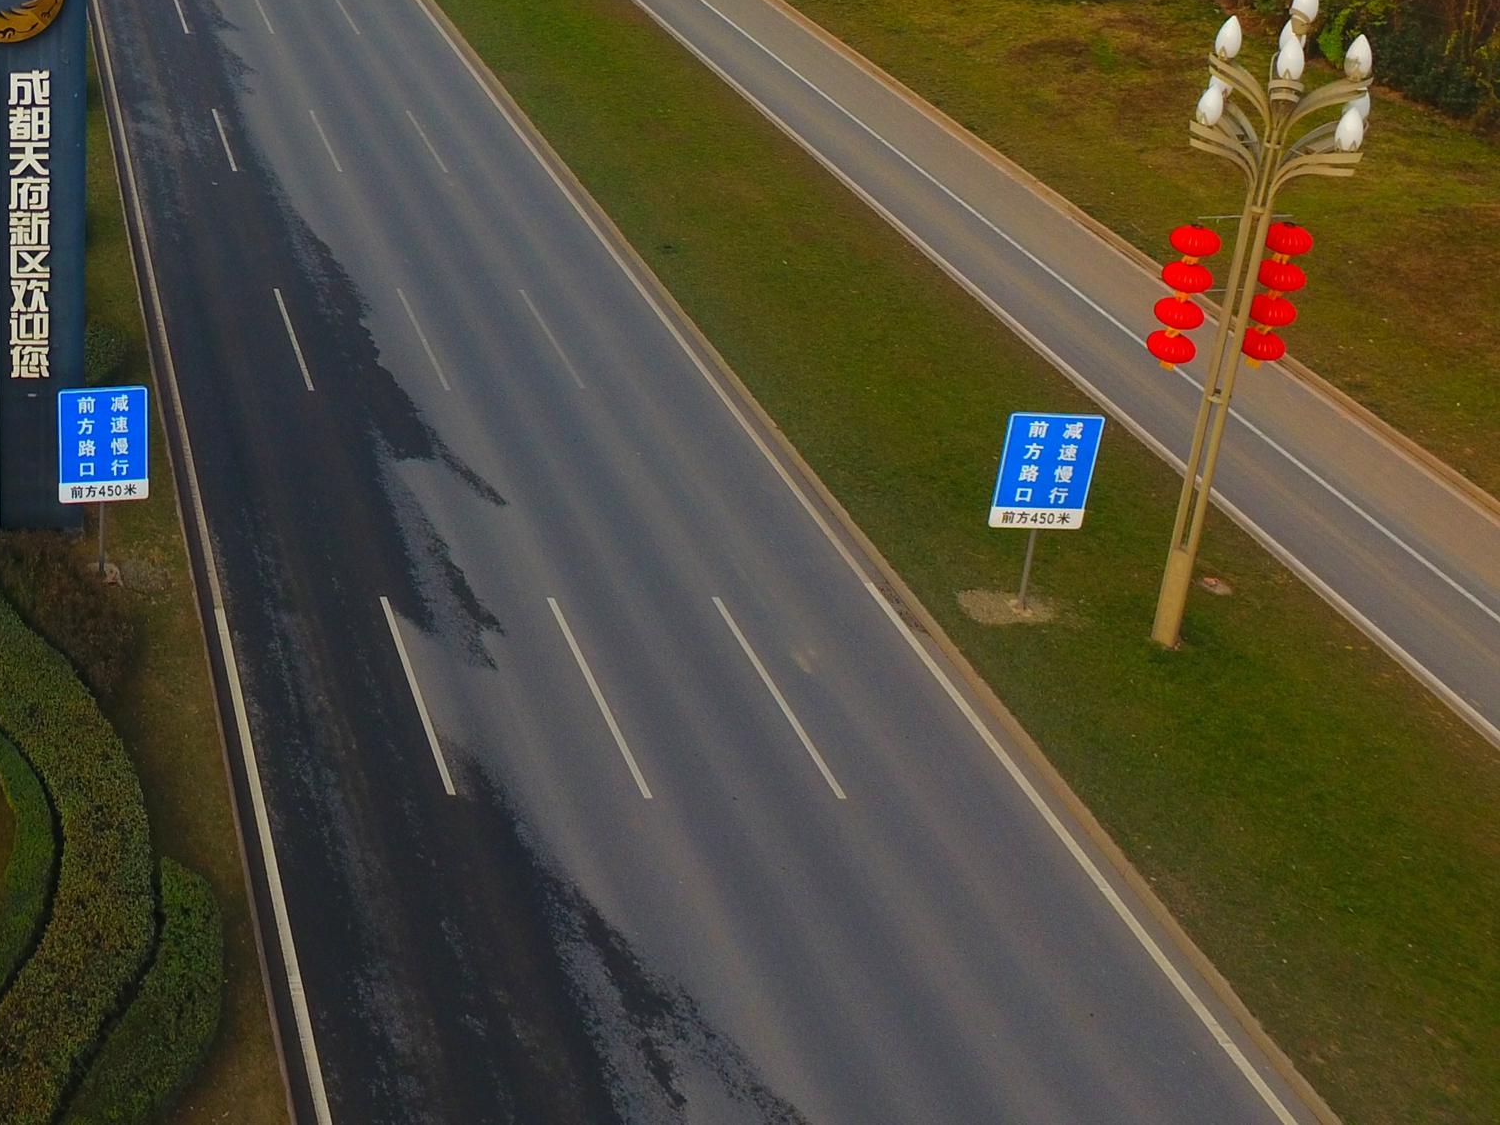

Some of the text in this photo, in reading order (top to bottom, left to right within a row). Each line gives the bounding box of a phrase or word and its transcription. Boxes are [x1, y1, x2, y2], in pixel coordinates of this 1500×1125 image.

[8, 70, 50, 379] 成都天府新区欢迎您
[77, 396, 96, 477] 前方路口
[110, 394, 130, 477] 减速慢行
[1014, 420, 1050, 503] 前方路口
[1048, 421, 1085, 505] 减速慢行
[70, 483, 138, 500] 前方450米
[1001, 511, 1072, 526] 前方450米
